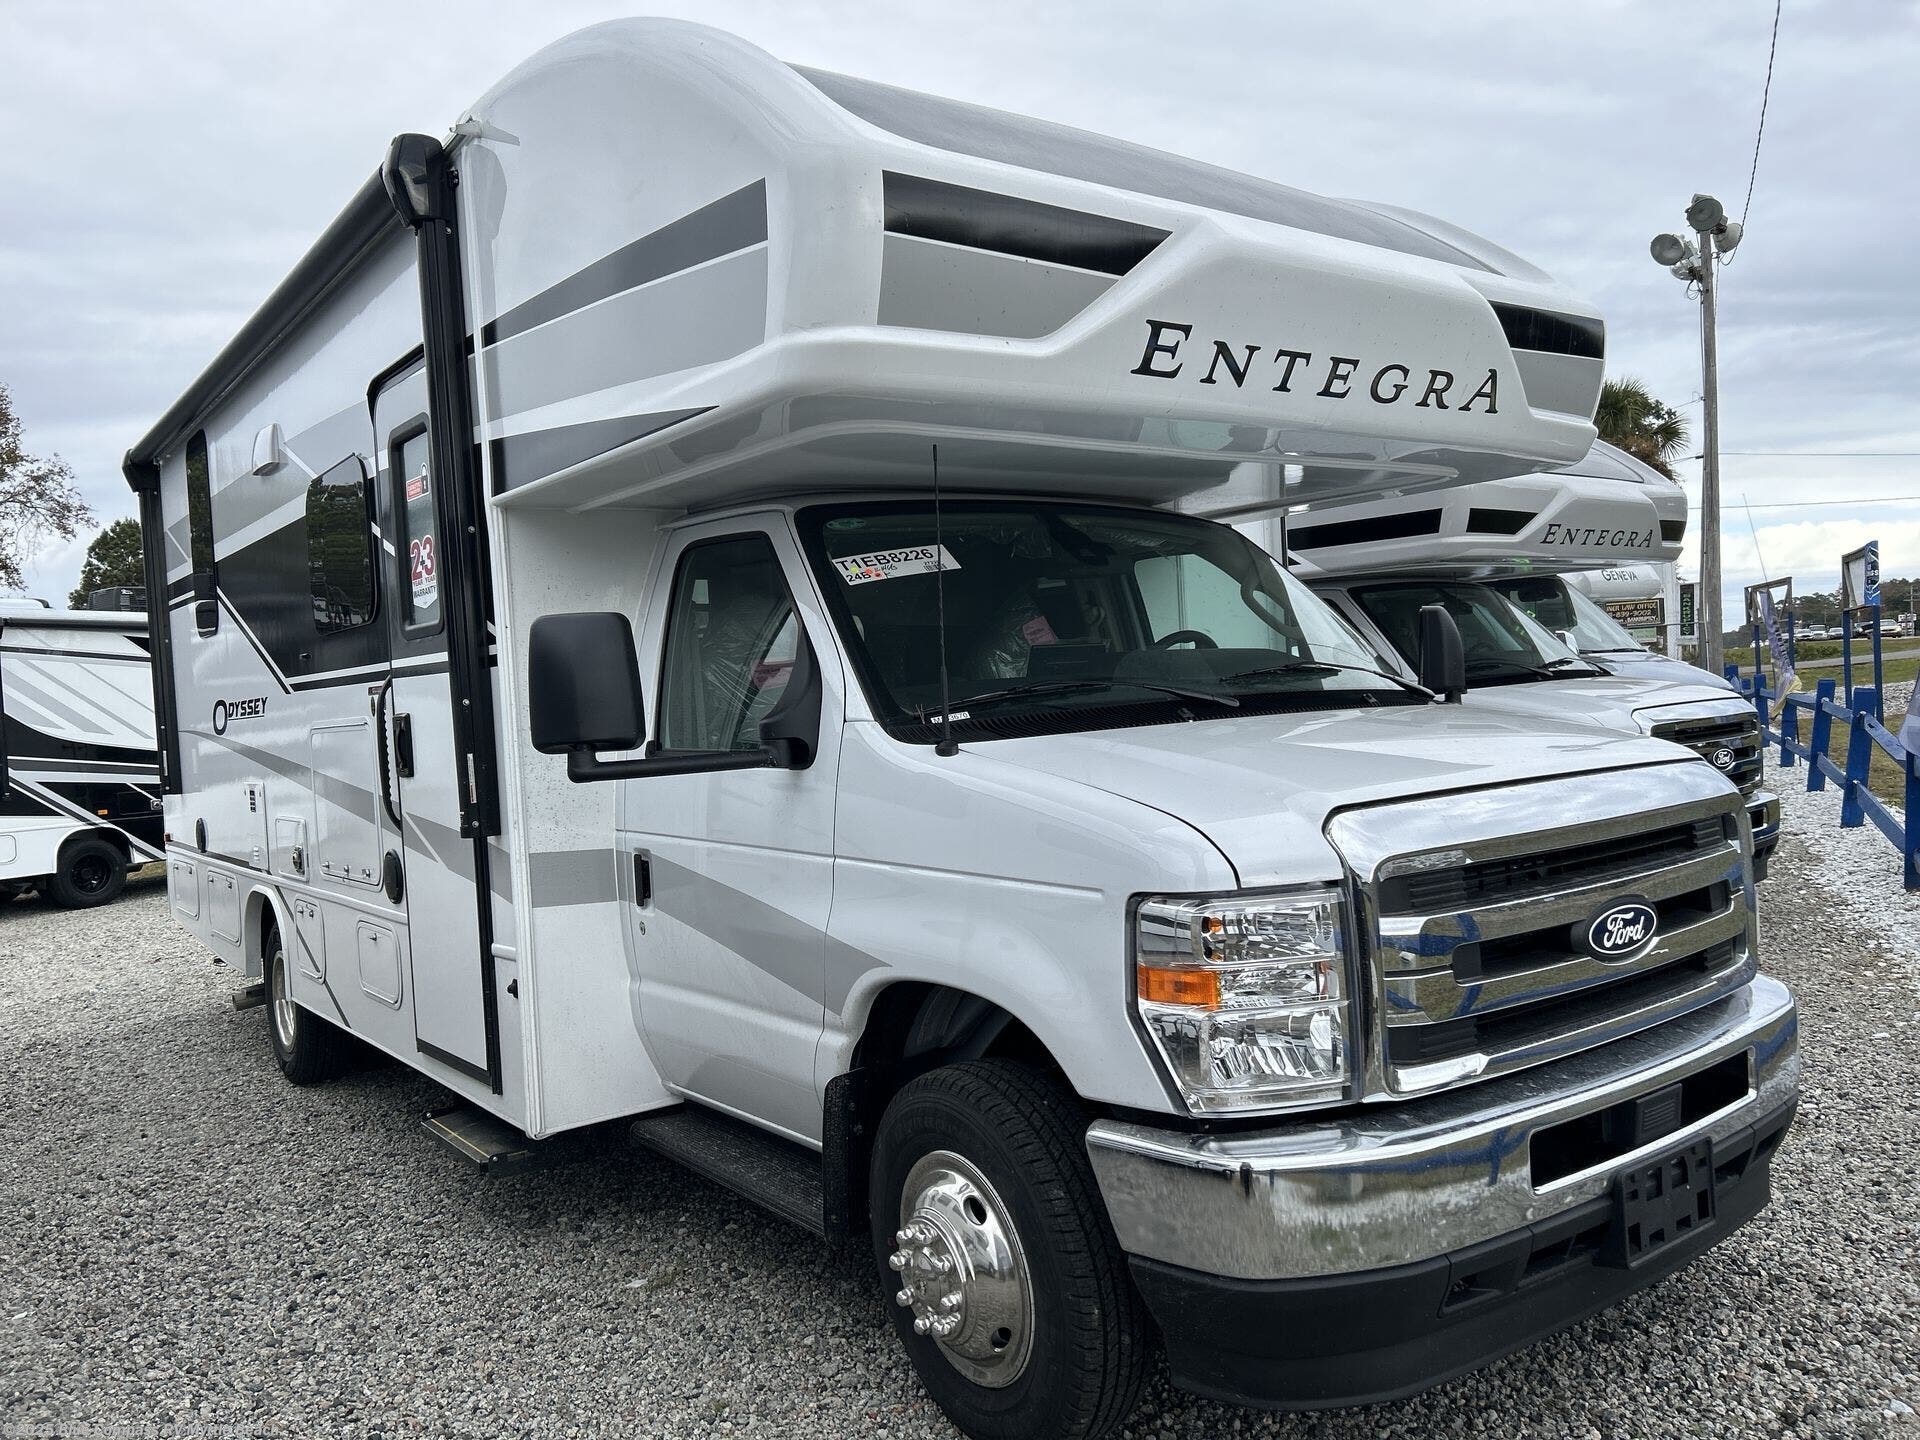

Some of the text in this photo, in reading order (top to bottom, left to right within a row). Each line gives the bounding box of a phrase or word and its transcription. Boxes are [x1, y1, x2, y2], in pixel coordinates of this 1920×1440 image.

[836, 548, 934, 571] T1EB8226
[1601, 570, 1639, 581] GENEVA
[1621, 603, 1635, 611] LAW
[1604, 912, 1645, 948] Ford
